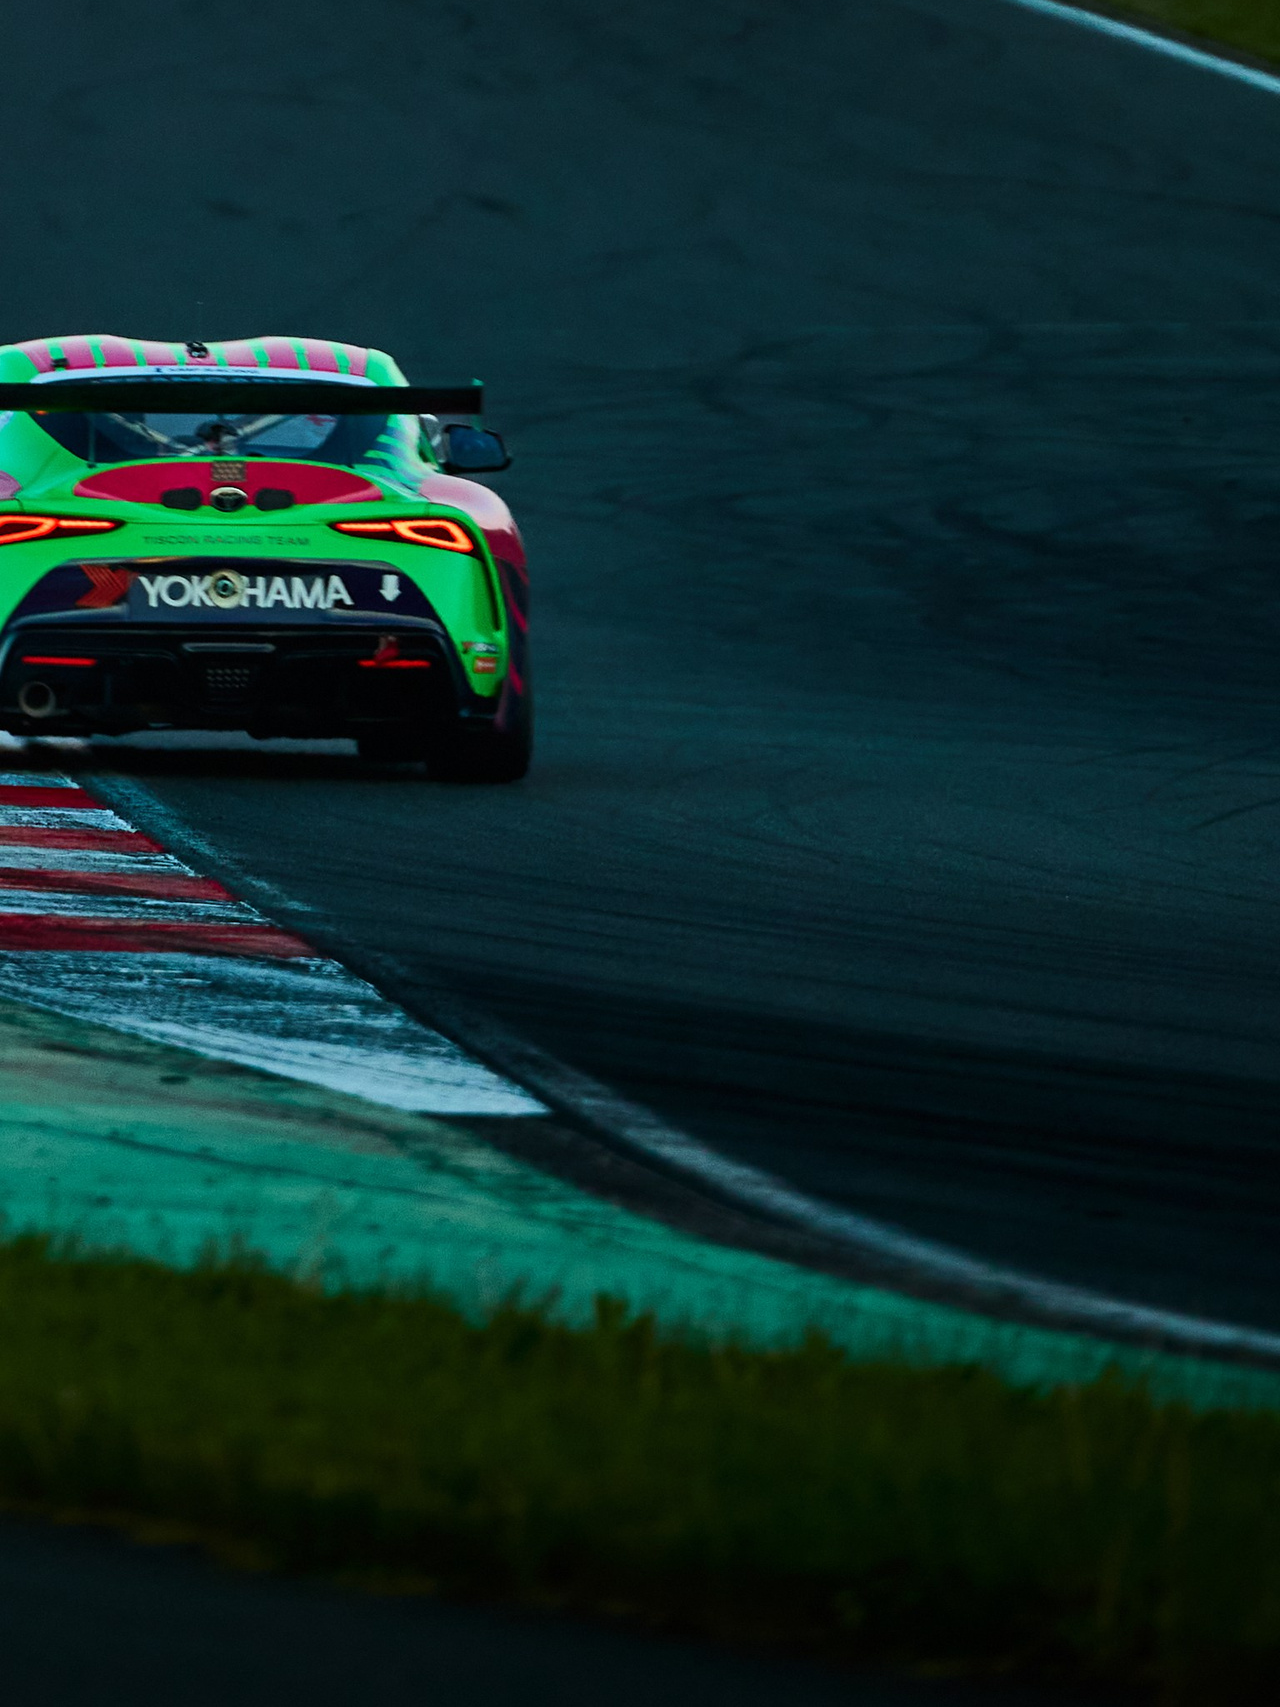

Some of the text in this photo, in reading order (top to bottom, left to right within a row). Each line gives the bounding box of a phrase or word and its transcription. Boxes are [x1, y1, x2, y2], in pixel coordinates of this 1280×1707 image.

[203, 535, 263, 545] RACING
[266, 535, 311, 546] TEAM
[138, 573, 355, 609] YOKHAMA
